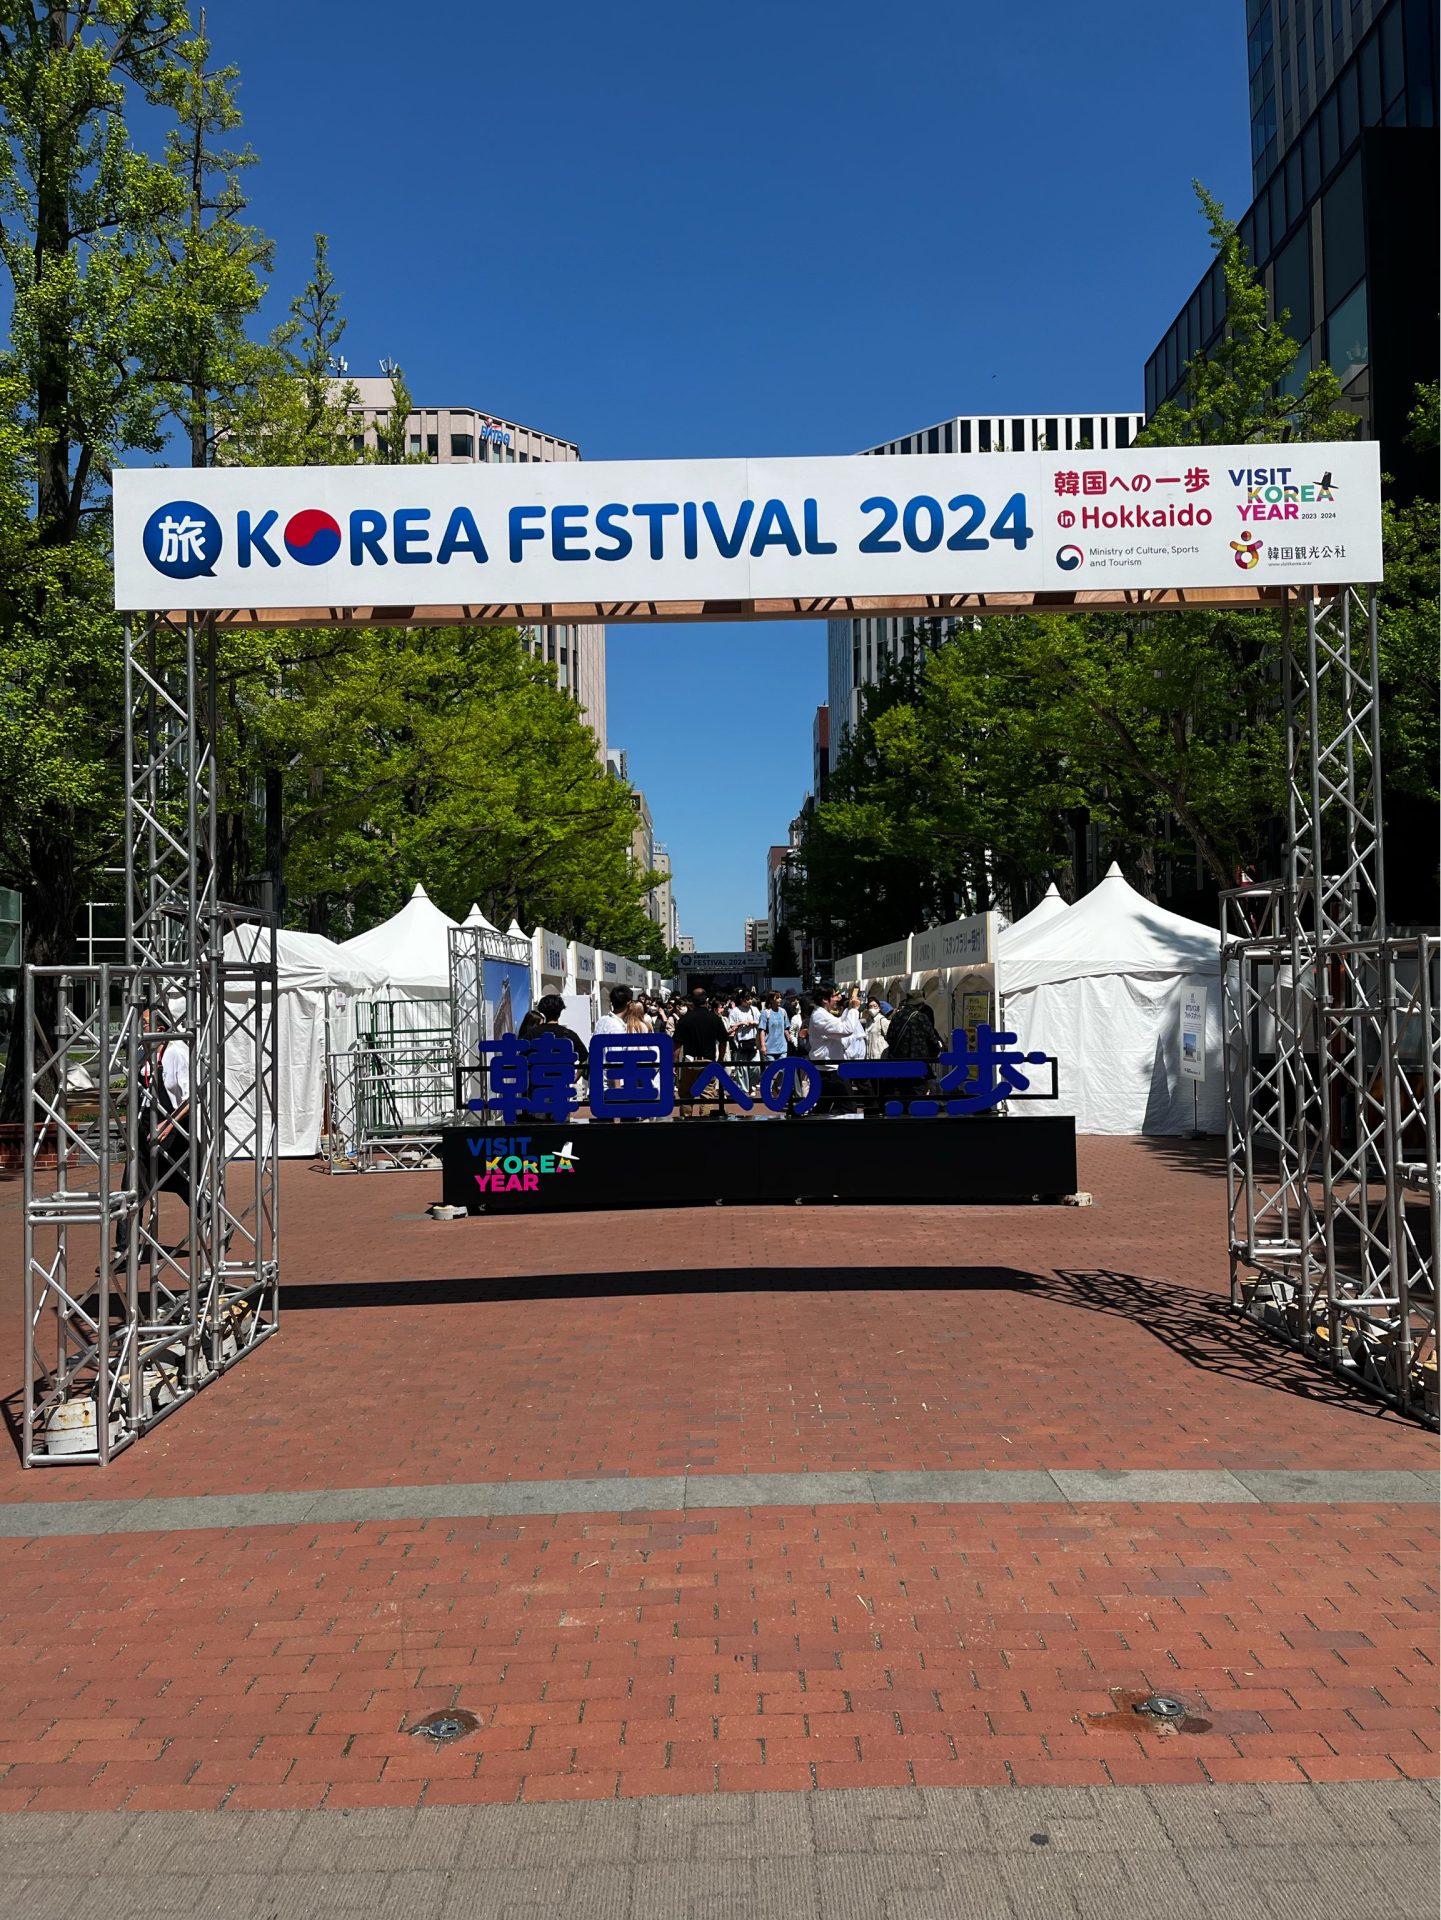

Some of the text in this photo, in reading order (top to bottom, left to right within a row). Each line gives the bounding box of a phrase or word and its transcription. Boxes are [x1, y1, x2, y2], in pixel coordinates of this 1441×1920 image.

[1054, 467, 1210, 496] 韓国への一歩
[1228, 468, 1291, 486] VISIT
[1248, 485, 1334, 504] KOREA
[1061, 503, 1212, 528] in Hokkaido
[1237, 504, 1298, 521] YEAR
[509, 500, 835, 562] FESTIVAL
[859, 493, 1034, 554] 2024
[158, 515, 206, 562] 旅
[1090, 547, 1123, 556] Ministry
[1136, 546, 1169, 554] Culture,
[1171, 546, 1199, 554] Sports
[1268, 545, 1346, 560] 韓国観光公社
[1090, 559, 1106, 567] and
[478, 1024, 1029, 1124] 韓国への一歩
[467, 1137, 532, 1156] VISIT
[486, 1155, 574, 1174] KOREA
[474, 1175, 539, 1192] YEAR
